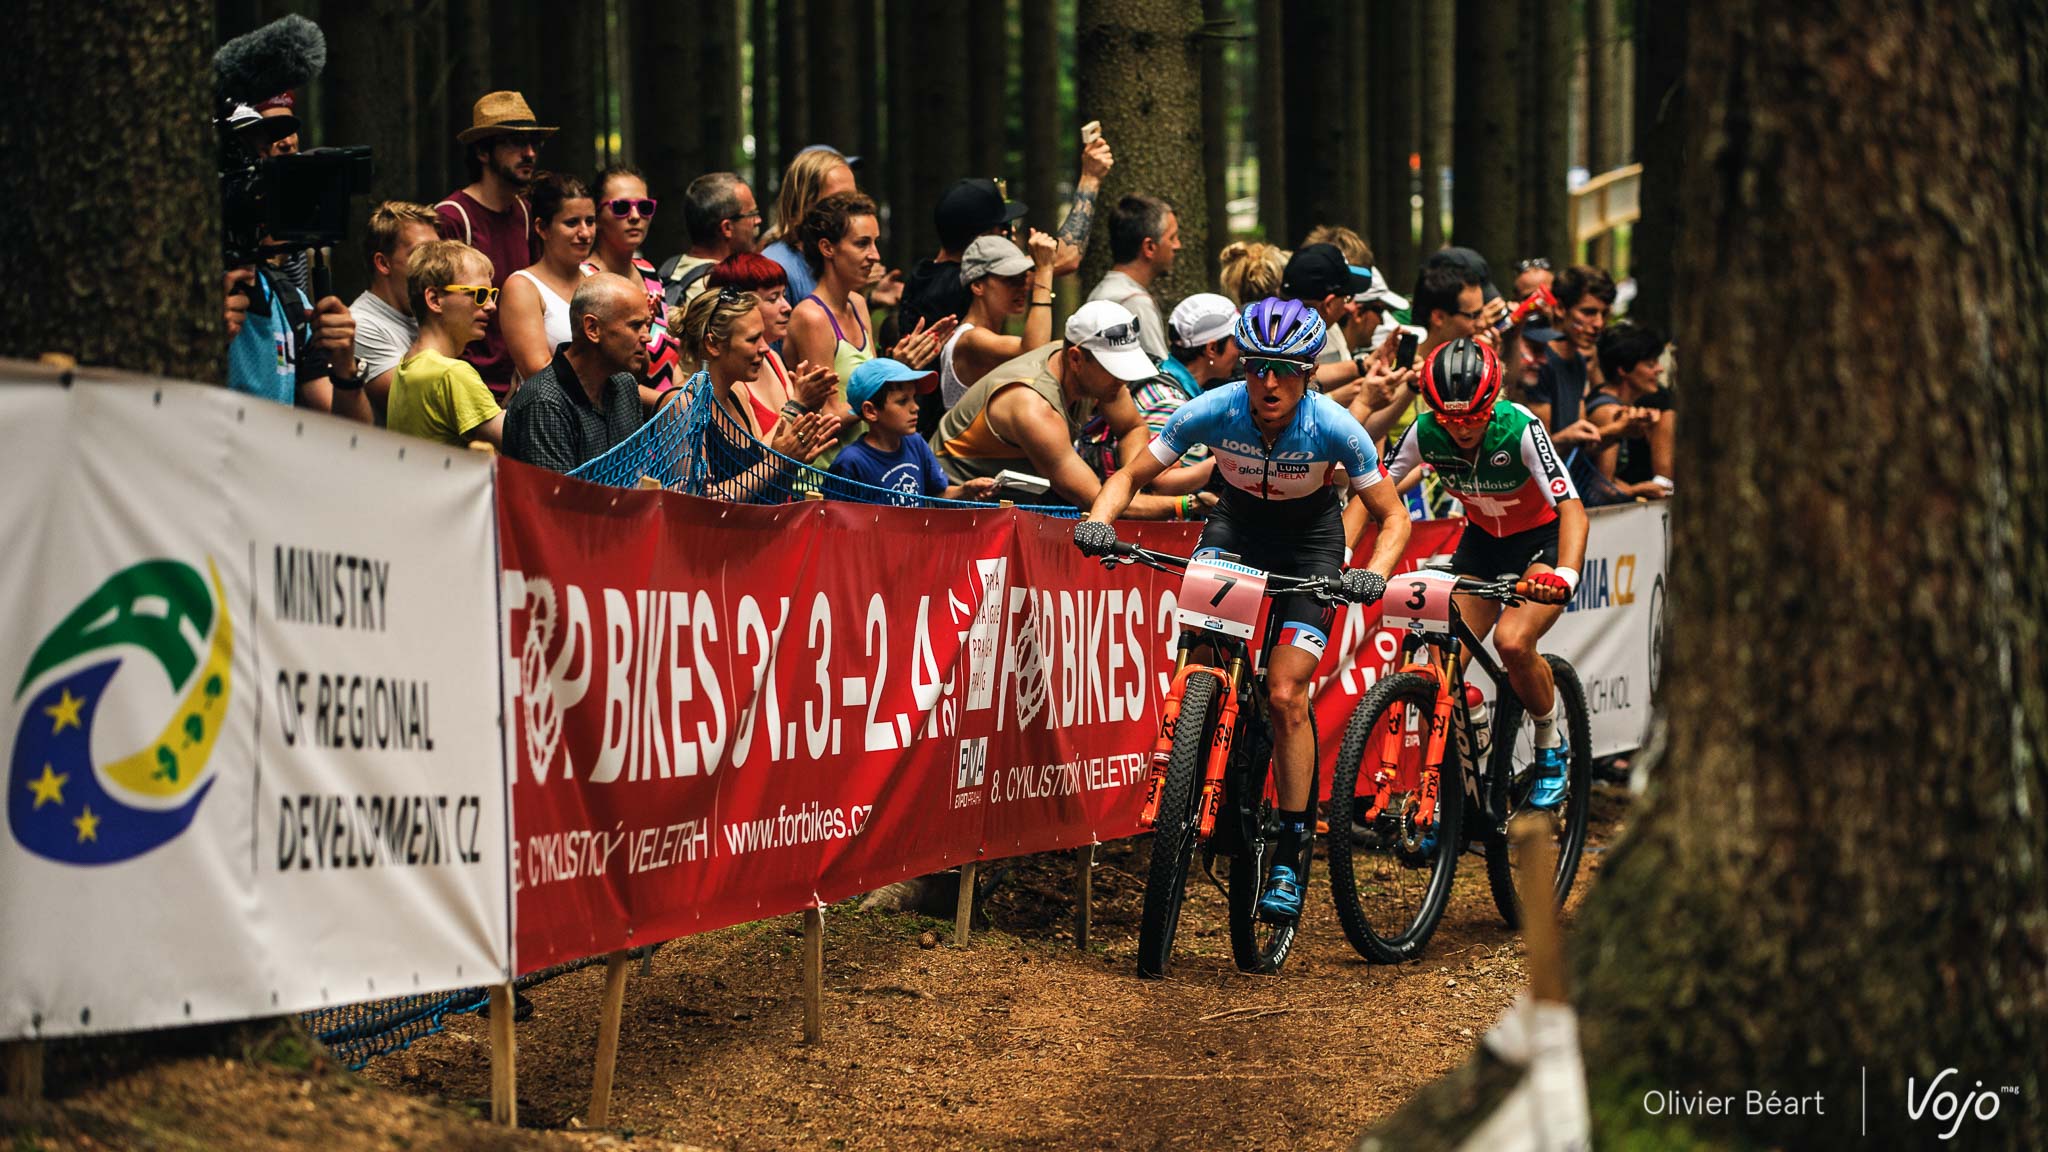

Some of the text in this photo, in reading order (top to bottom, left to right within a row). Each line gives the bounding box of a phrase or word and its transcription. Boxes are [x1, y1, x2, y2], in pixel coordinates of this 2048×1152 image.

[1221, 439, 1265, 458] LOOK
[1279, 464, 1307, 472] LUNA
[1277, 472, 1307, 480] RELAY
[273, 544, 390, 632] MINISTRY
[1209, 573, 1238, 608] 7
[1405, 581, 1427, 610] 3
[1060, 587, 1146, 728] BIKES
[589, 588, 727, 784] BIKES
[277, 671, 435, 752] OF REGIONAL
[990, 769, 1001, 804] 8.
[1083, 751, 1151, 791] VELETRH
[1146, 777, 1159, 804] FOX
[1426, 773, 1439, 800] FOX
[1209, 788, 1221, 816] FOX
[277, 795, 448, 871] DEVELOPMENT
[628, 817, 708, 874] VELETRH
[724, 800, 873, 856] www.forbikes.cz
